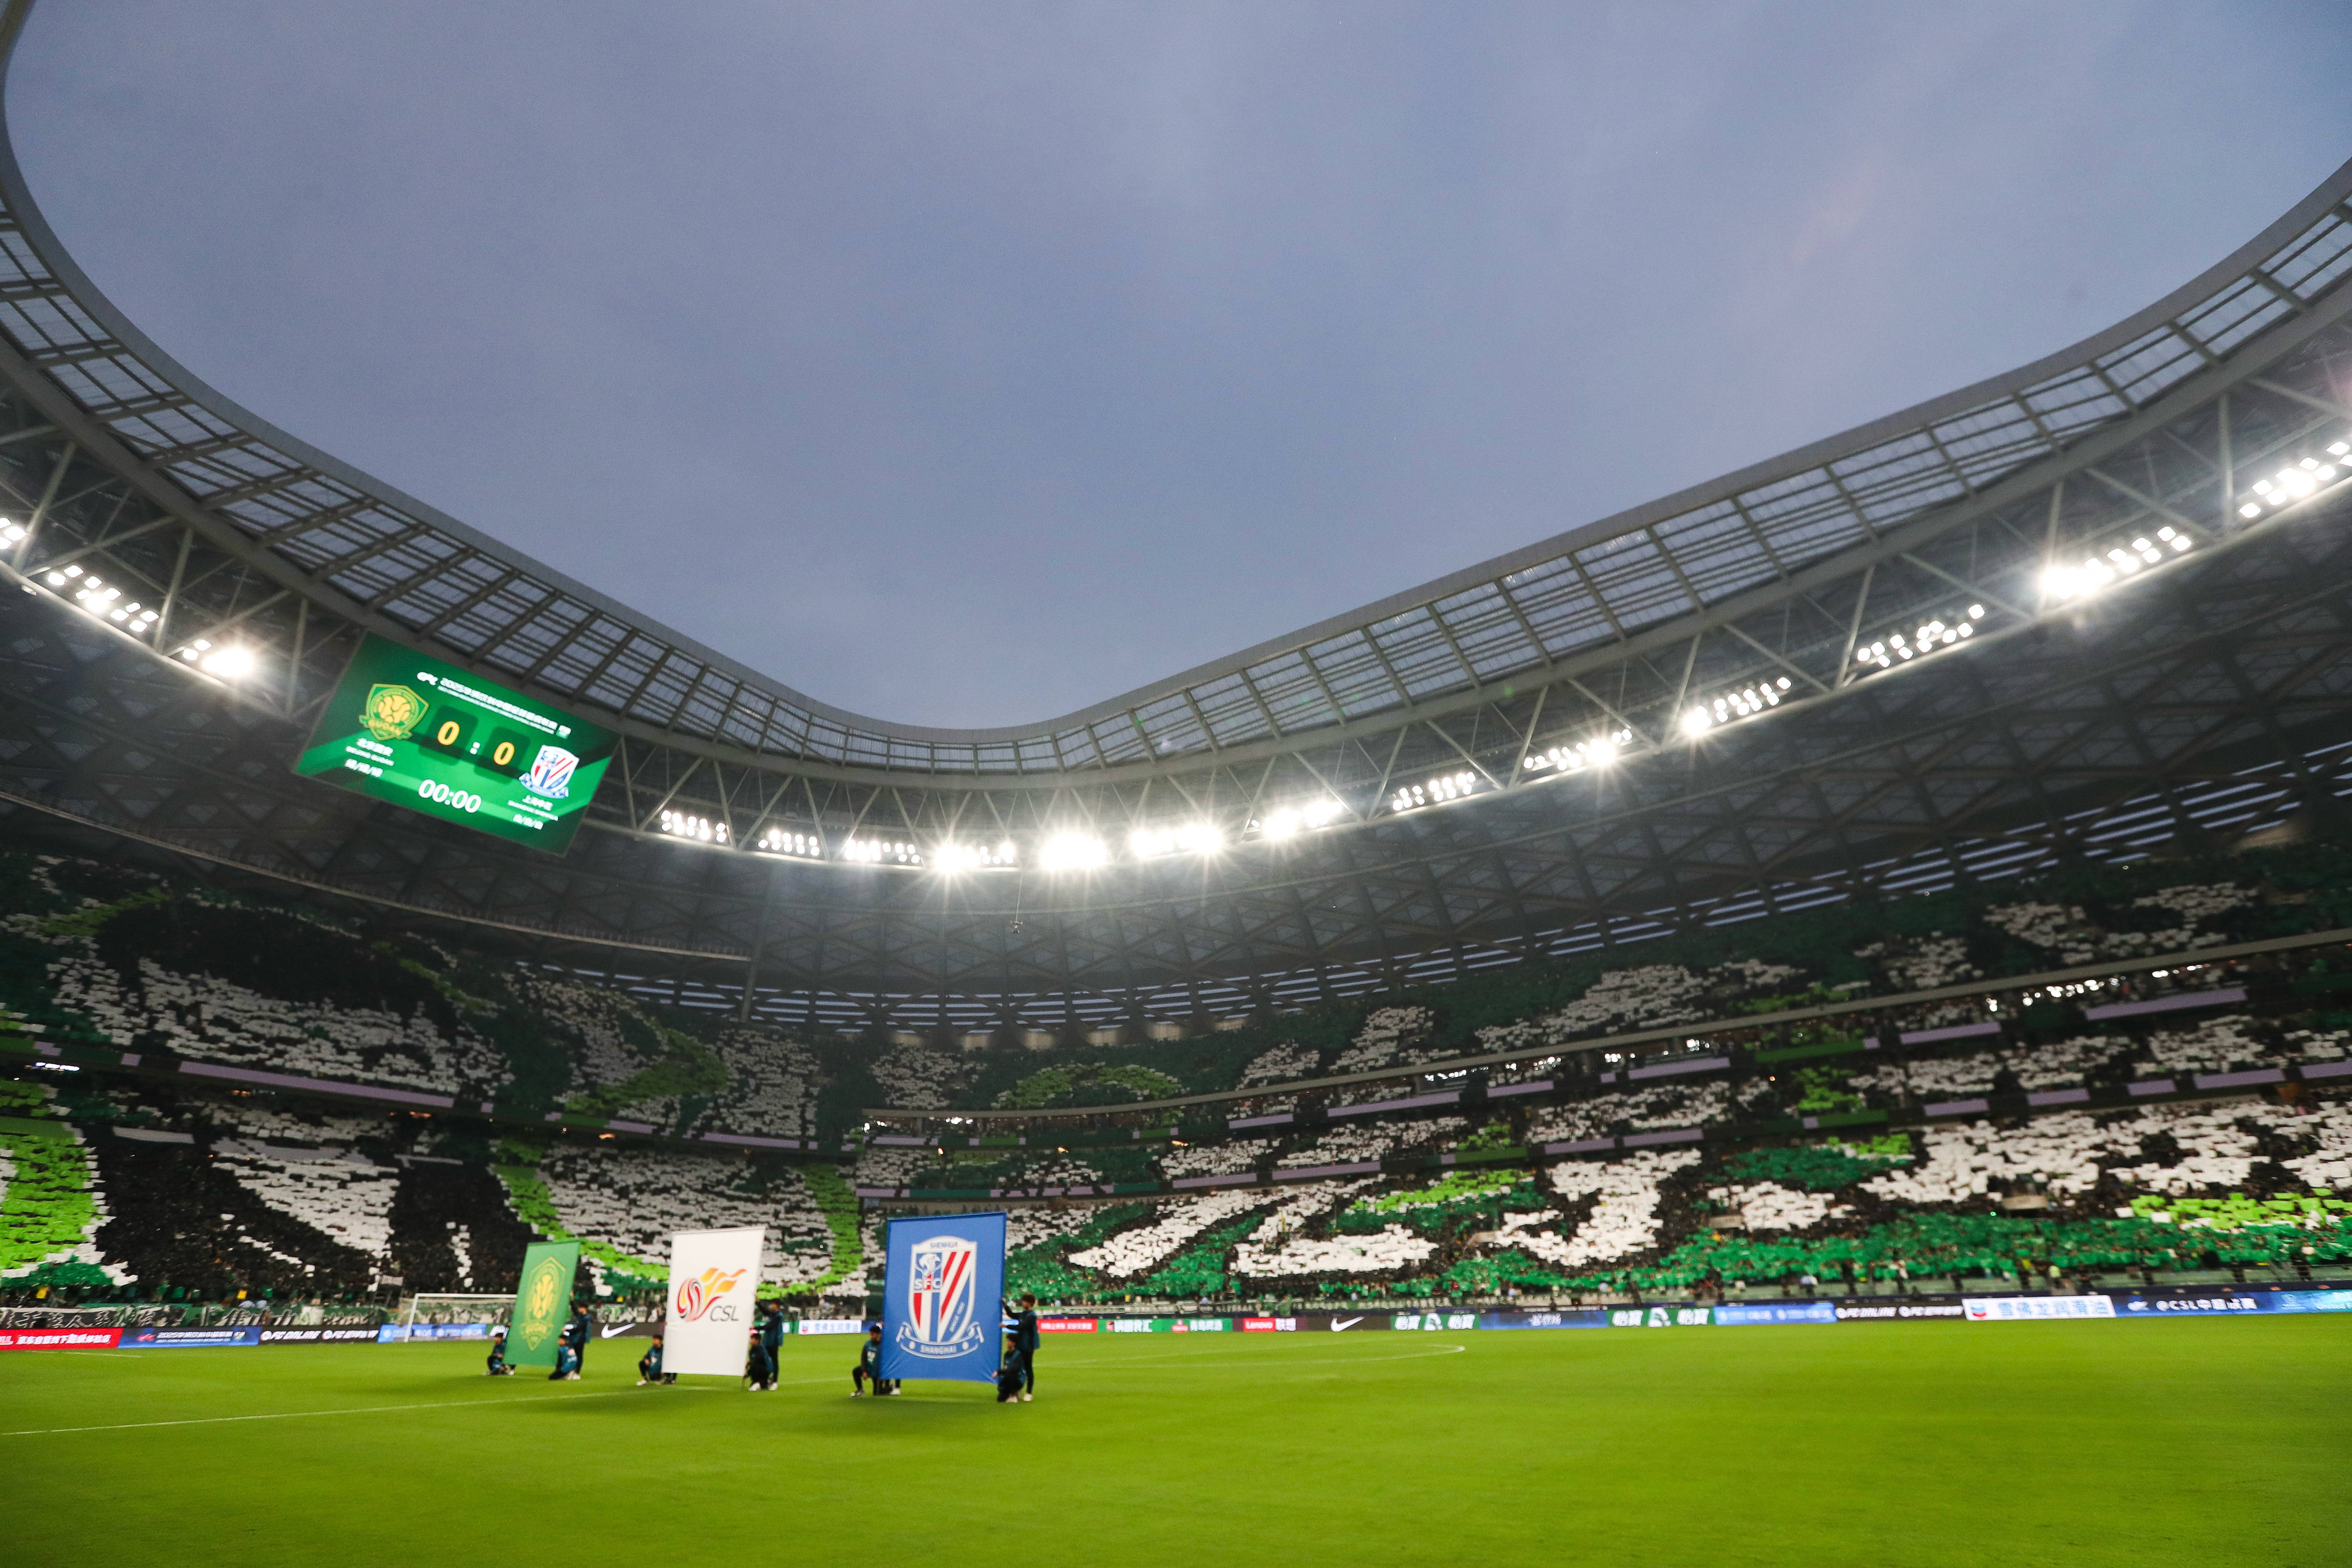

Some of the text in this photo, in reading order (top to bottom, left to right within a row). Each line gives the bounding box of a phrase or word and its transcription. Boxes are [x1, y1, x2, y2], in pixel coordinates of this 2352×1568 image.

[437, 721, 460, 745] 0
[494, 742, 514, 765] 0
[418, 780, 482, 813] 00:00
[710, 1305, 738, 1322] CSL
[1245, 1321, 1273, 1330] Lenovo
[283, 1330, 321, 1340] ONLINE
